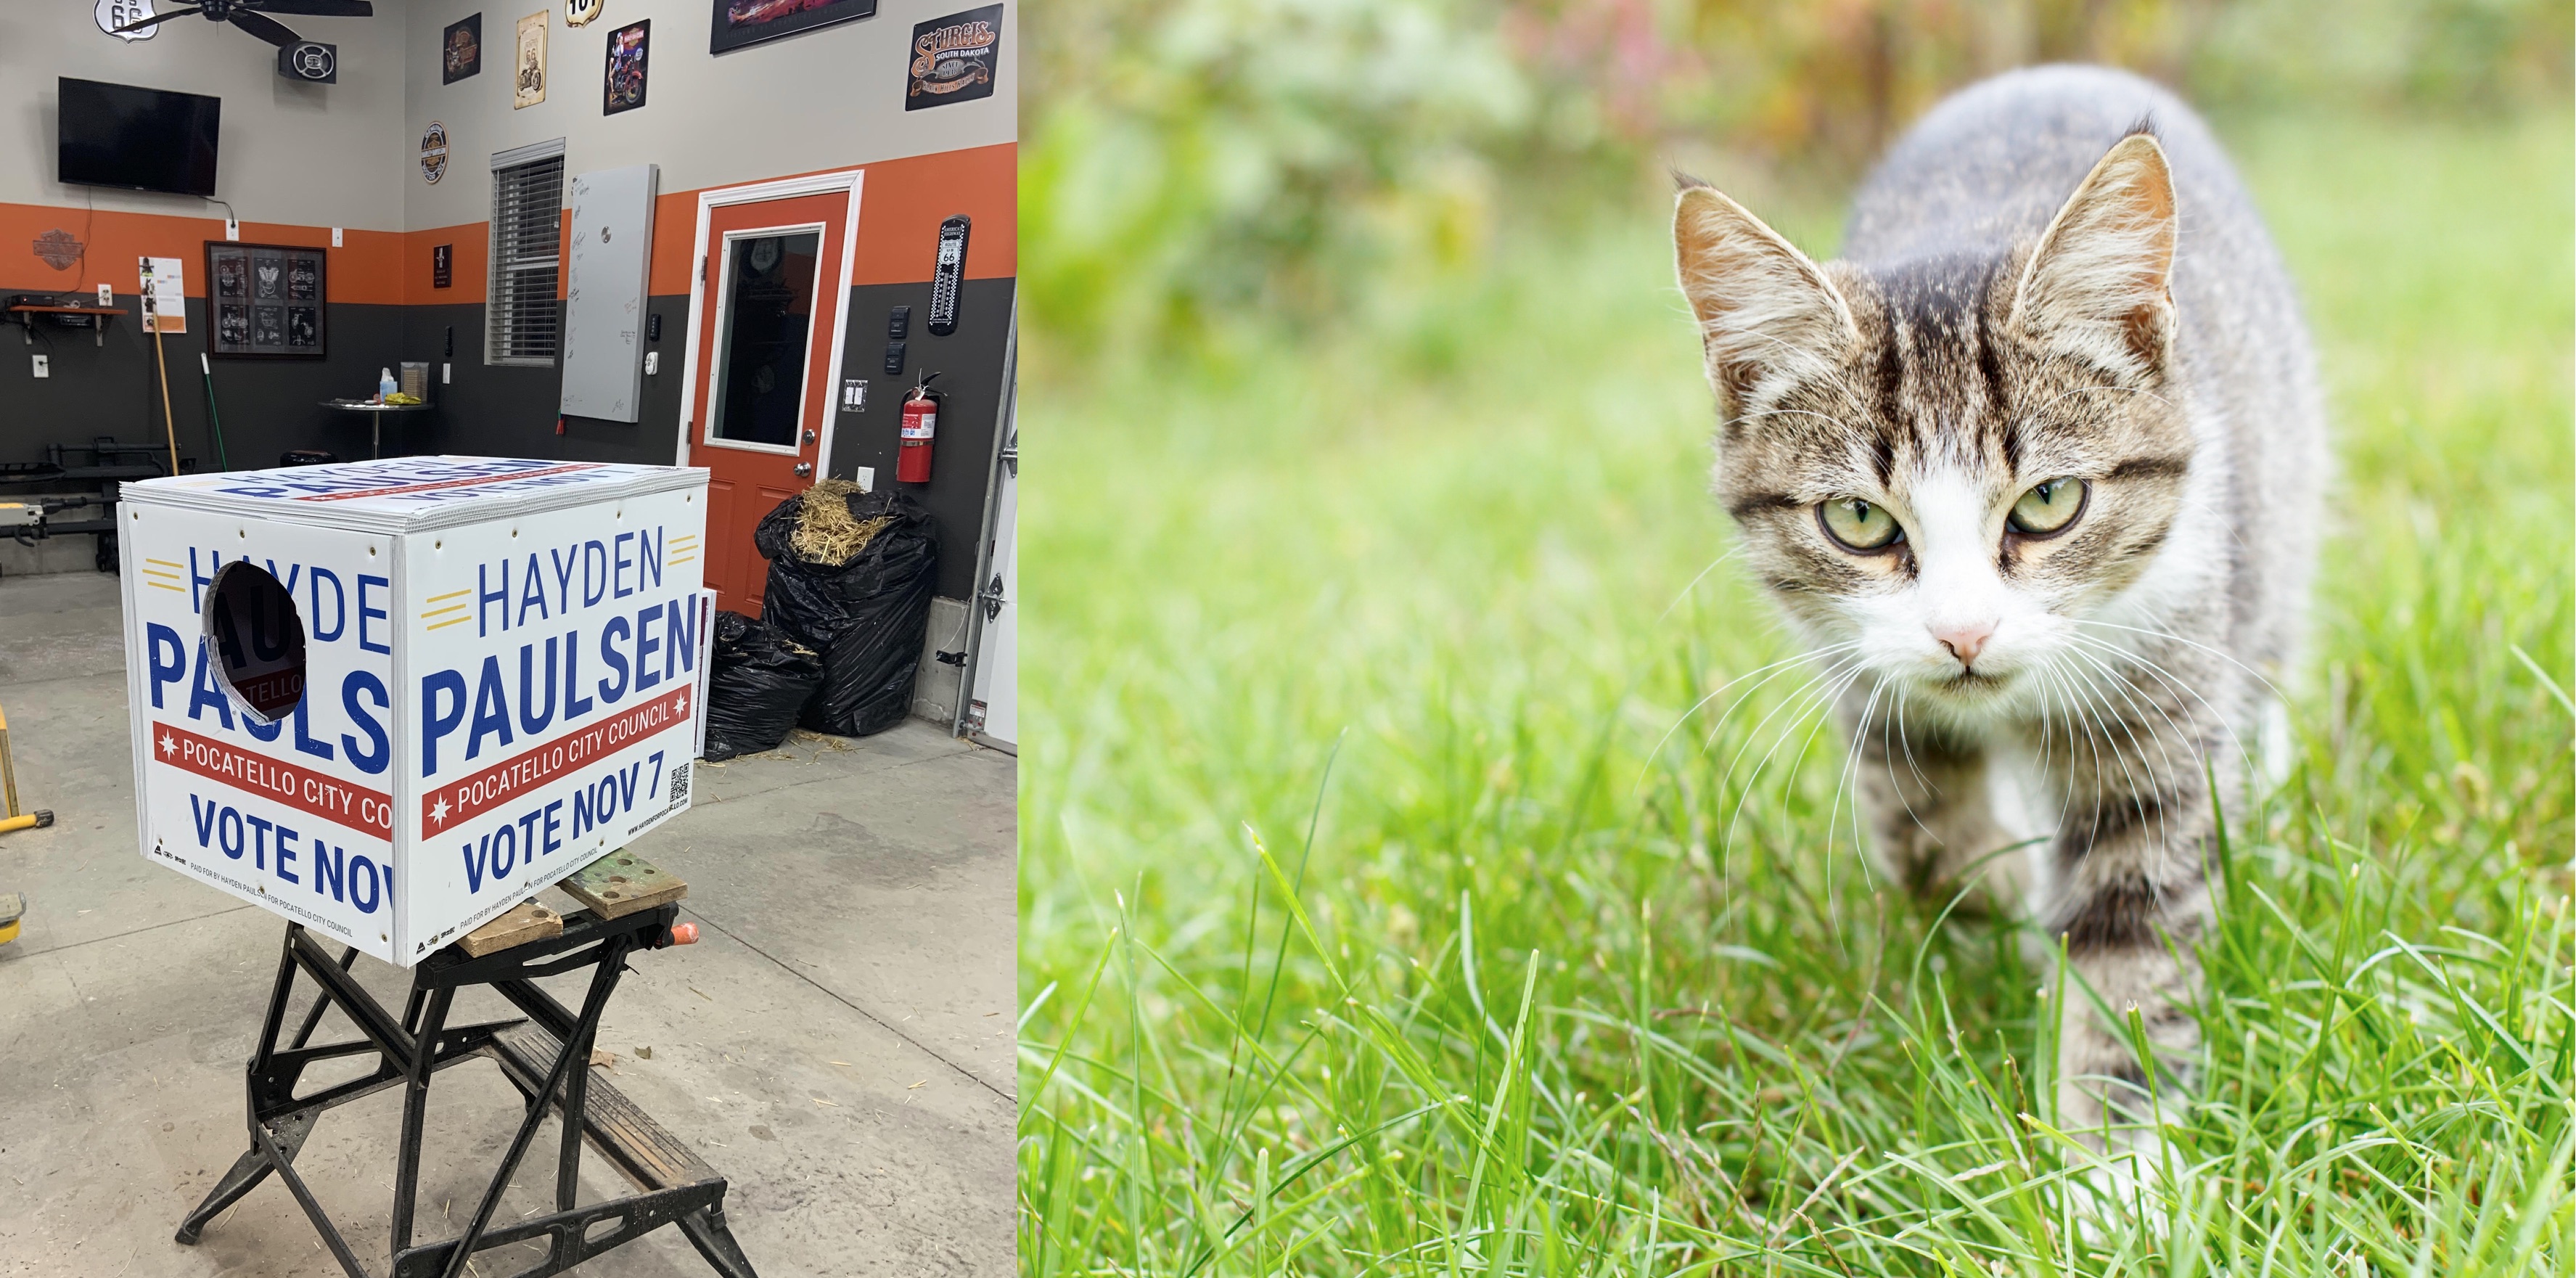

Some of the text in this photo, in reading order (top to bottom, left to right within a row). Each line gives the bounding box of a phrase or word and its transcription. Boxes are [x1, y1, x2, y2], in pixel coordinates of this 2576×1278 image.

[112, 5, 142, 34] 66
[911, 21, 996, 78] STURGIS
[936, 47, 989, 61] SOUTH DAKOTA
[943, 253, 955, 262] 66
[214, 459, 570, 499] PAULSEN
[221, 460, 454, 484] HAYDEN
[385, 485, 534, 501] VOTE
[479, 525, 663, 639] HAYDEN
[422, 593, 697, 778] PAULSEN
[184, 739, 295, 796] POCATELLO
[304, 778, 353, 815] CITY
[458, 701, 670, 814] POCATELLO CITY COUNCIL
[189, 793, 299, 885] VOTE
[462, 750, 665, 895] VOTE NOV 7
[190, 862, 202, 873] PAID
[202, 867, 213, 877] FOR
[213, 872, 221, 880] BY
[221, 875, 242, 890] HAYDEN
[268, 894, 279, 906] FOR
[279, 899, 311, 919] POCATELLO
[312, 913, 326, 926] CITY
[327, 919, 353, 938] COUNCIL
[460, 917, 472, 930] PAID
[473, 912, 484, 925] FOR
[484, 906, 491, 918] BY
[491, 896, 512, 913] HAYDEN
[533, 877, 543, 887] FOR
[543, 863, 569, 882] POCATELLO
[570, 858, 580, 869] CITY
[580, 847, 597, 862] COUNCIL
